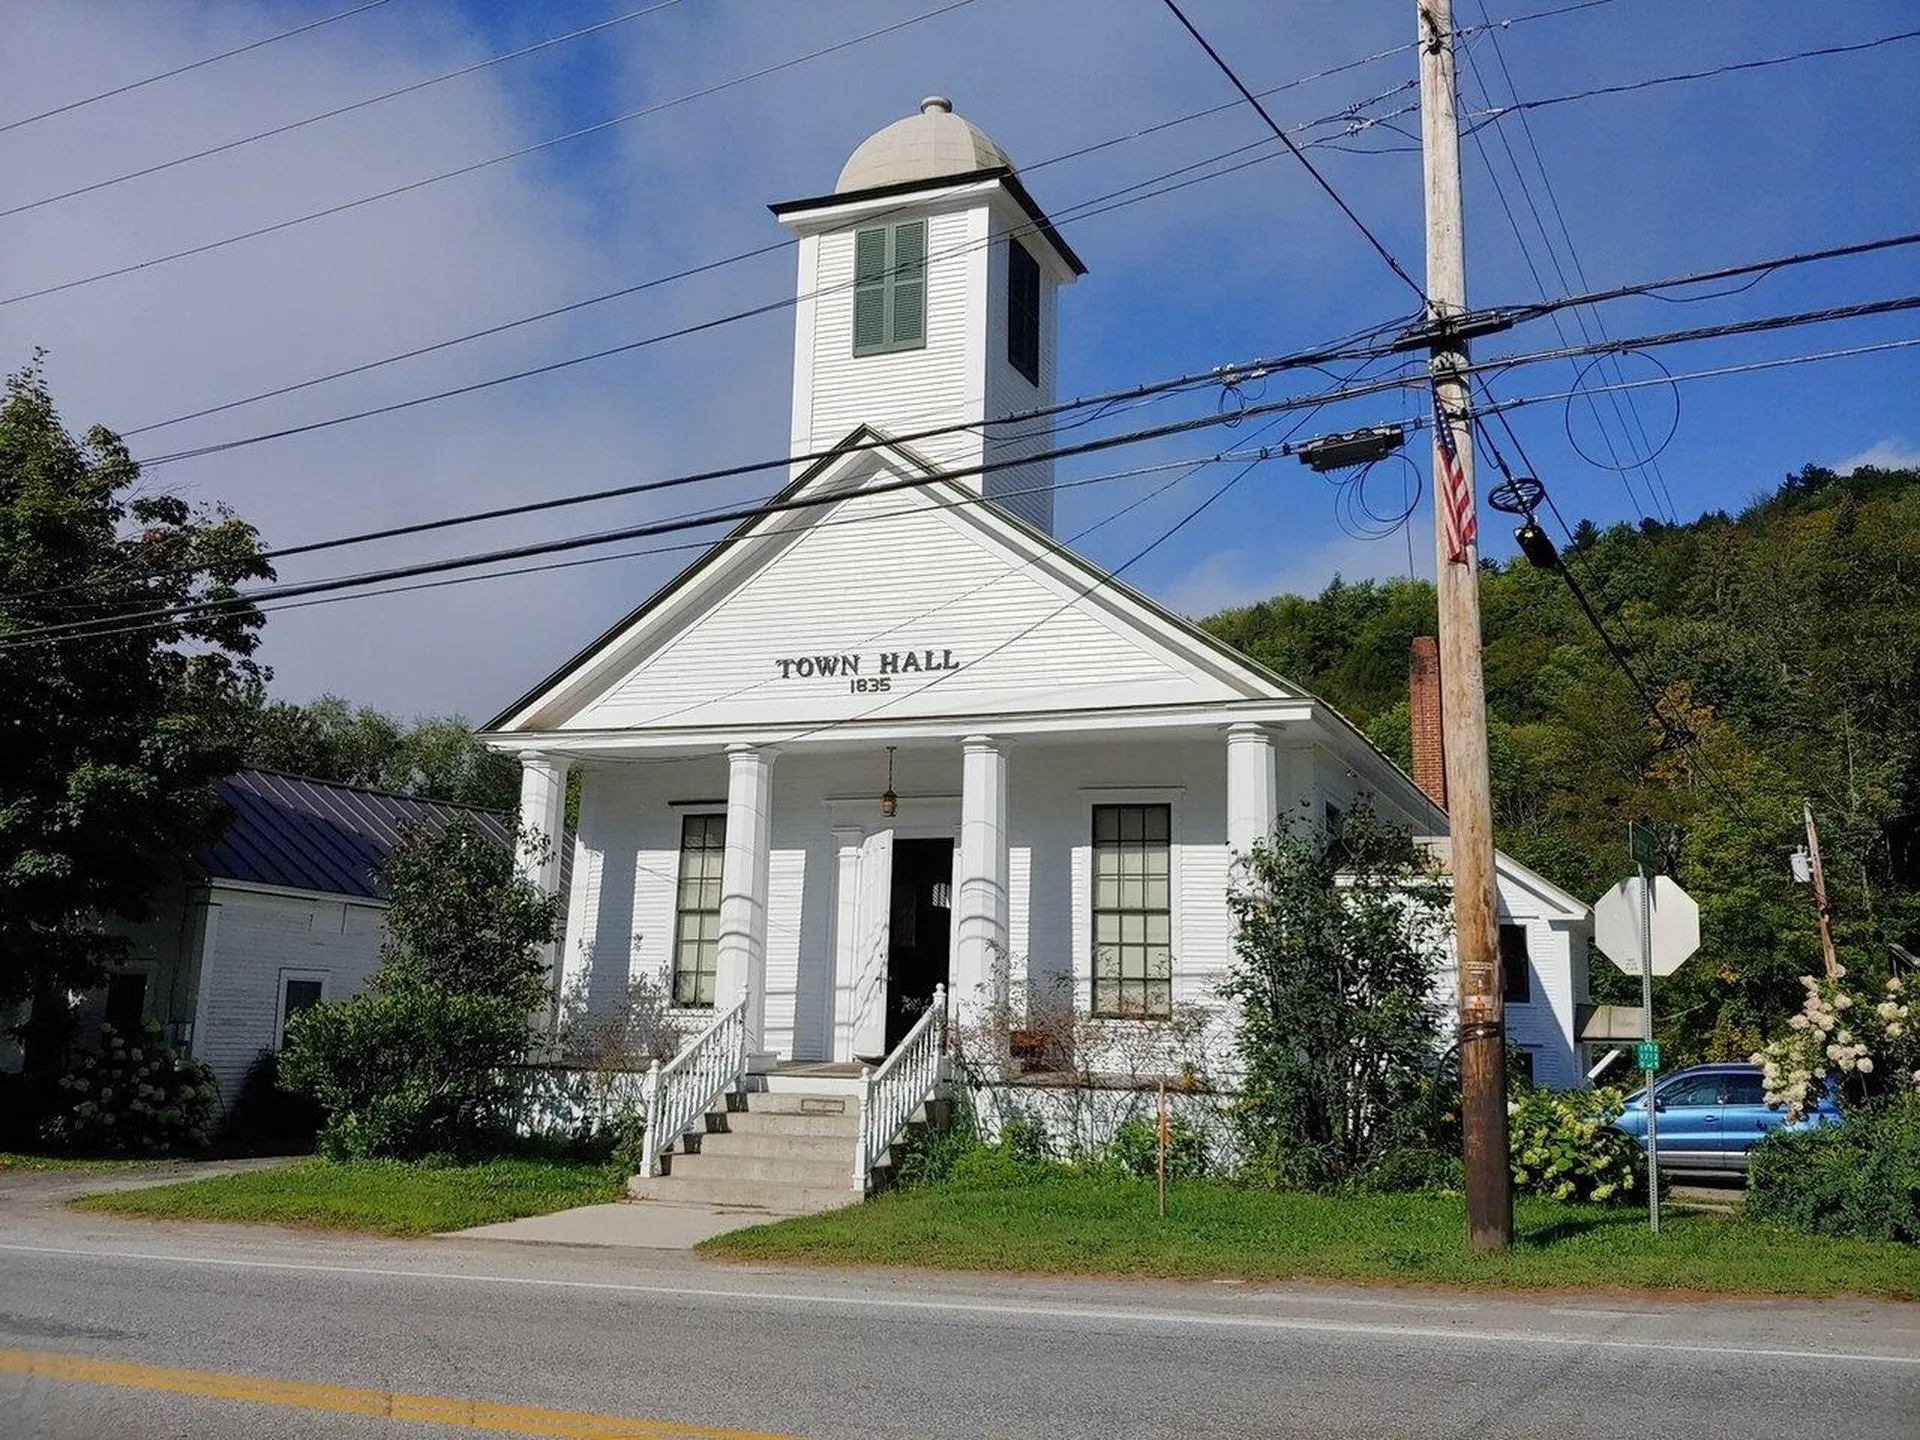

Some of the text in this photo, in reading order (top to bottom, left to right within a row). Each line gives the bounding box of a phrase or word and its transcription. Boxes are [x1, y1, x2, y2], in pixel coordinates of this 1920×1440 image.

[775, 649, 960, 679] TOWN HALL
[850, 677, 892, 694] 1835
